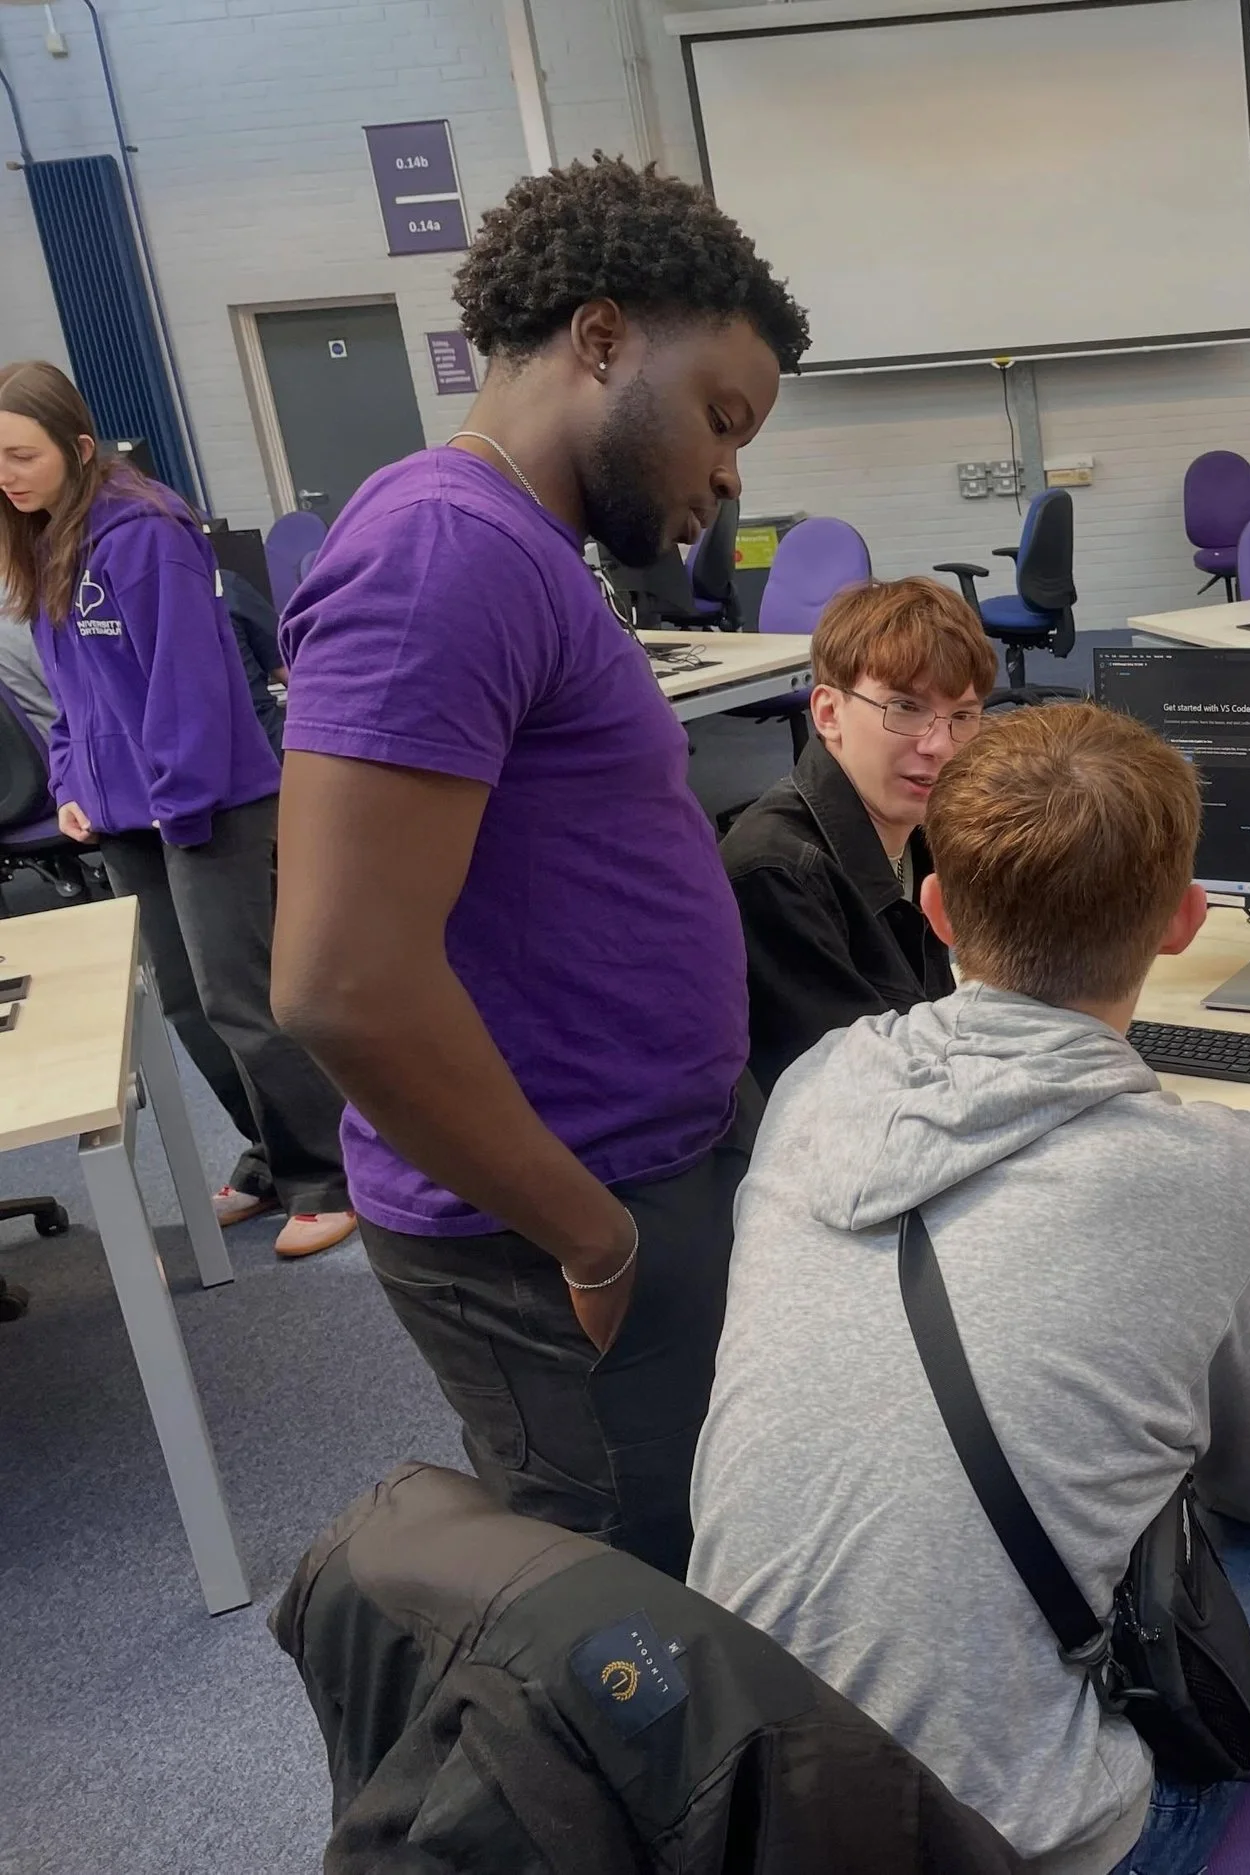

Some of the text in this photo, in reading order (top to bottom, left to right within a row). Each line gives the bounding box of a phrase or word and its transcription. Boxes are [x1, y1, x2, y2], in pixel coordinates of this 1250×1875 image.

[396, 156, 429, 169] 0.14b
[409, 220, 441, 233] 0.14a
[1163, 703, 1250, 713] Get started with VS Code
[668, 1642, 680, 1654] M
[631, 1631, 669, 1693] LINCOLN
